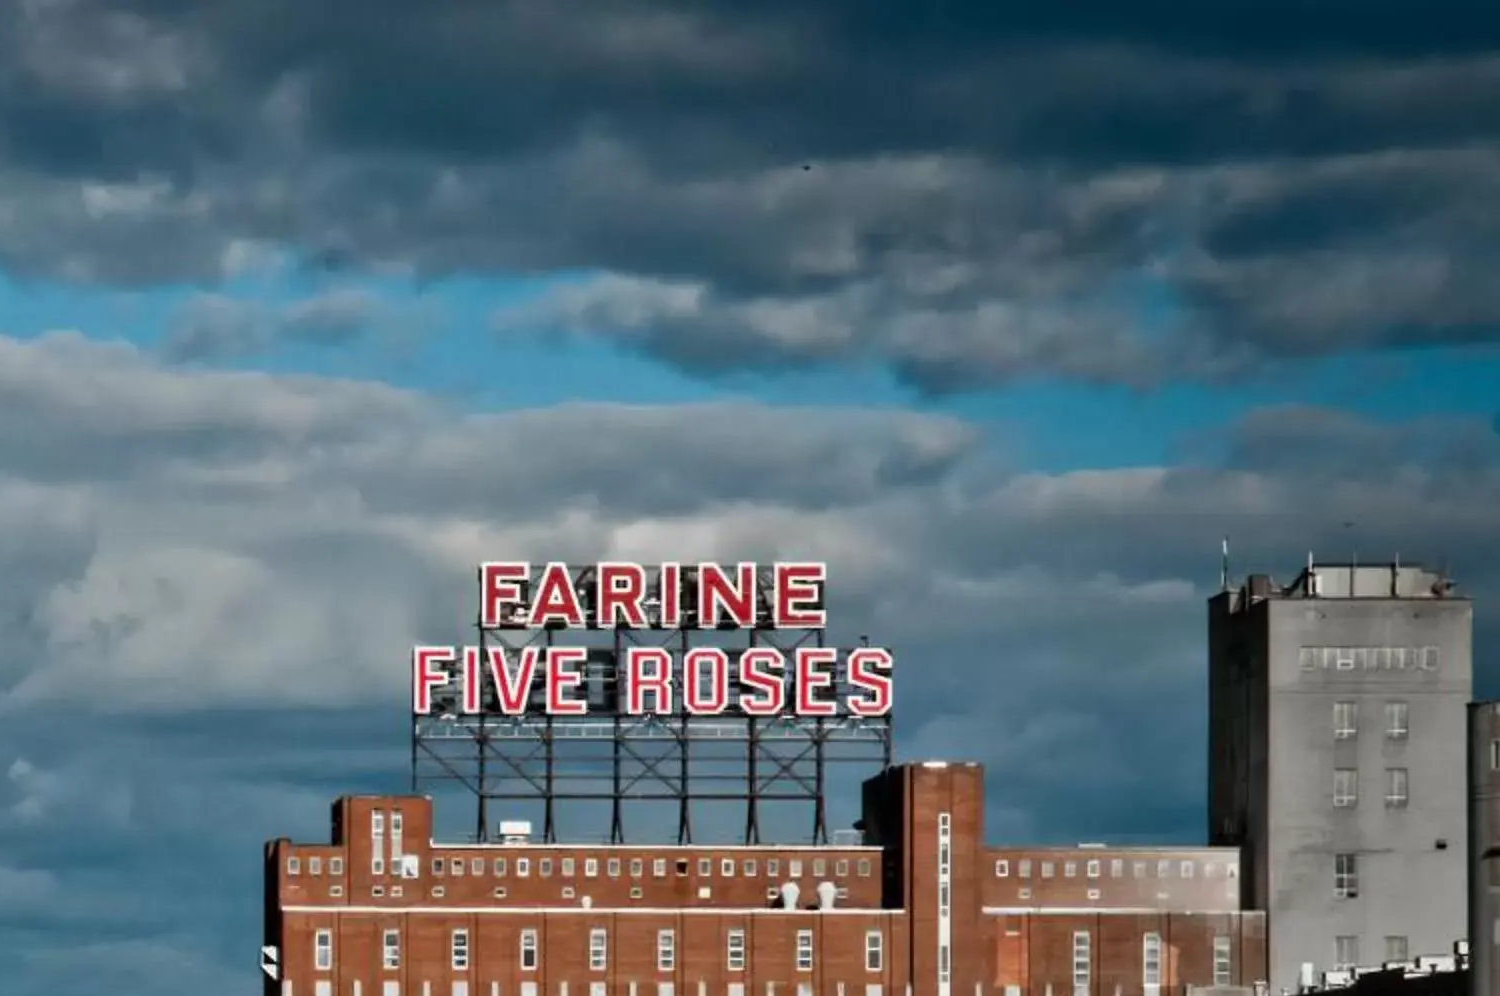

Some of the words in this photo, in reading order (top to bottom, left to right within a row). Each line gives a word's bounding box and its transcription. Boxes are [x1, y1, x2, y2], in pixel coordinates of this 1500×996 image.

[481, 561, 826, 629] FARINE
[414, 646, 588, 714] FIVE
[627, 647, 893, 715] ROSES
